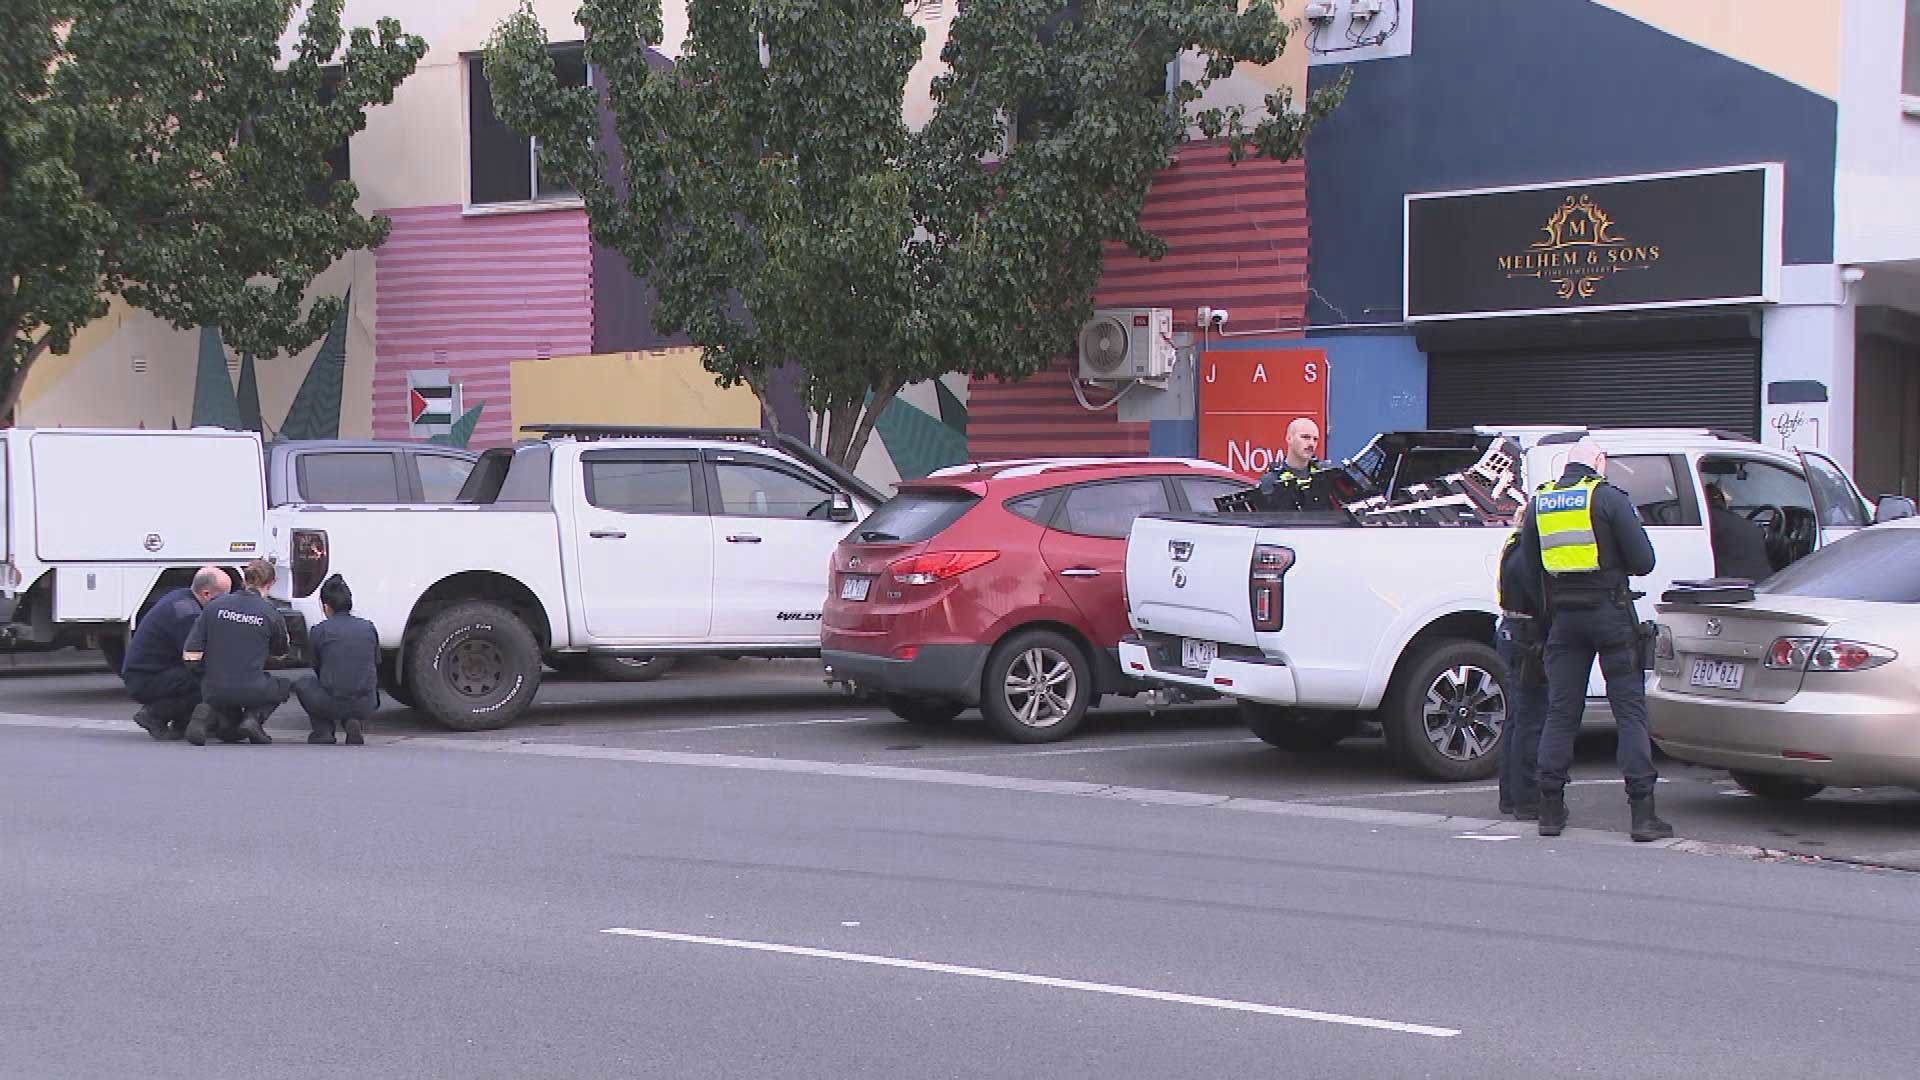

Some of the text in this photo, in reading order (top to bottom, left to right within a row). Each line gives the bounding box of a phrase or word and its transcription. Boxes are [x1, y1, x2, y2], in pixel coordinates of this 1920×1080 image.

[1569, 219, 1586, 236] M
[1498, 245, 1660, 271] MELHEM & SONS
[1539, 493, 1584, 511] Police
[217, 609, 264, 626] FORENSIC
[776, 611, 823, 621] WILDT
